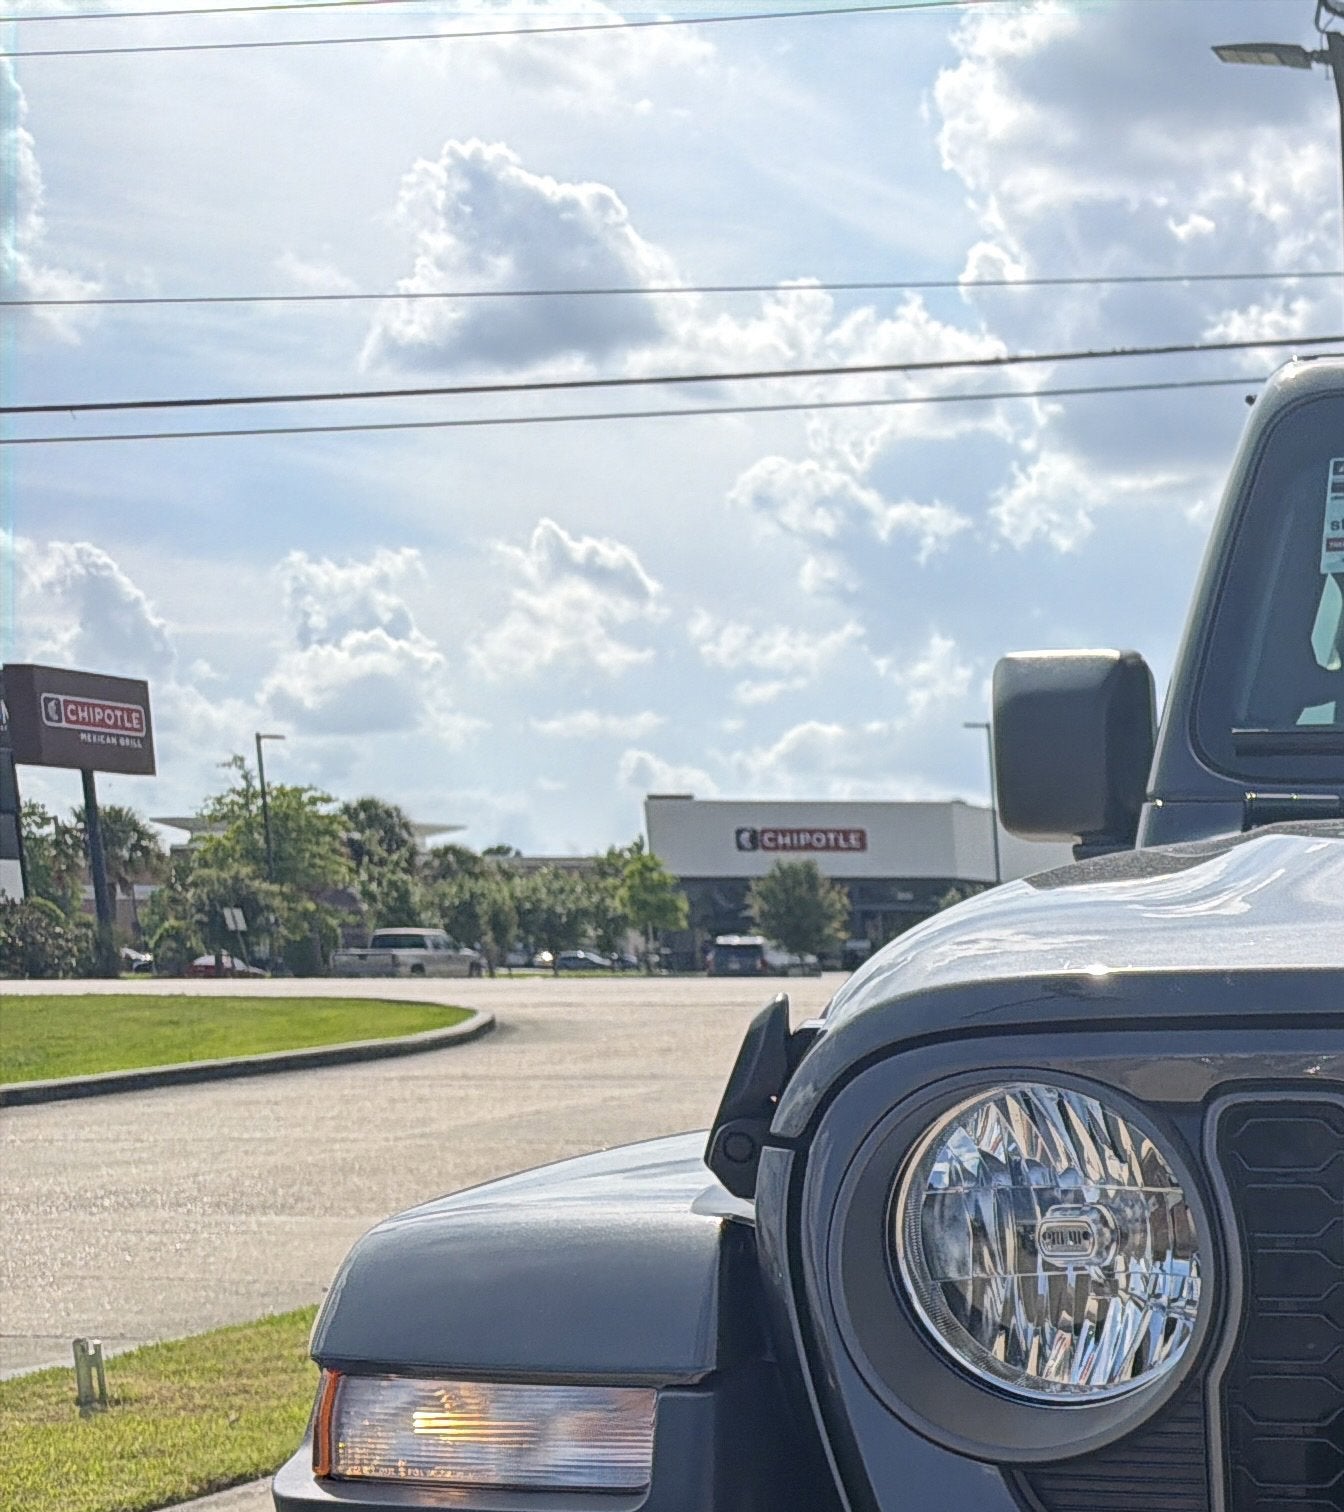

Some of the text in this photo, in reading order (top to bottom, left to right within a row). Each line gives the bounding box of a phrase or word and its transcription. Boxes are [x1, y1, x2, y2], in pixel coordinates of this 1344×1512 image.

[66, 704, 141, 729] CHIPOTLE
[80, 732, 142, 749] MEXICAN GRILL
[763, 831, 860, 849] CHIPOTLE
